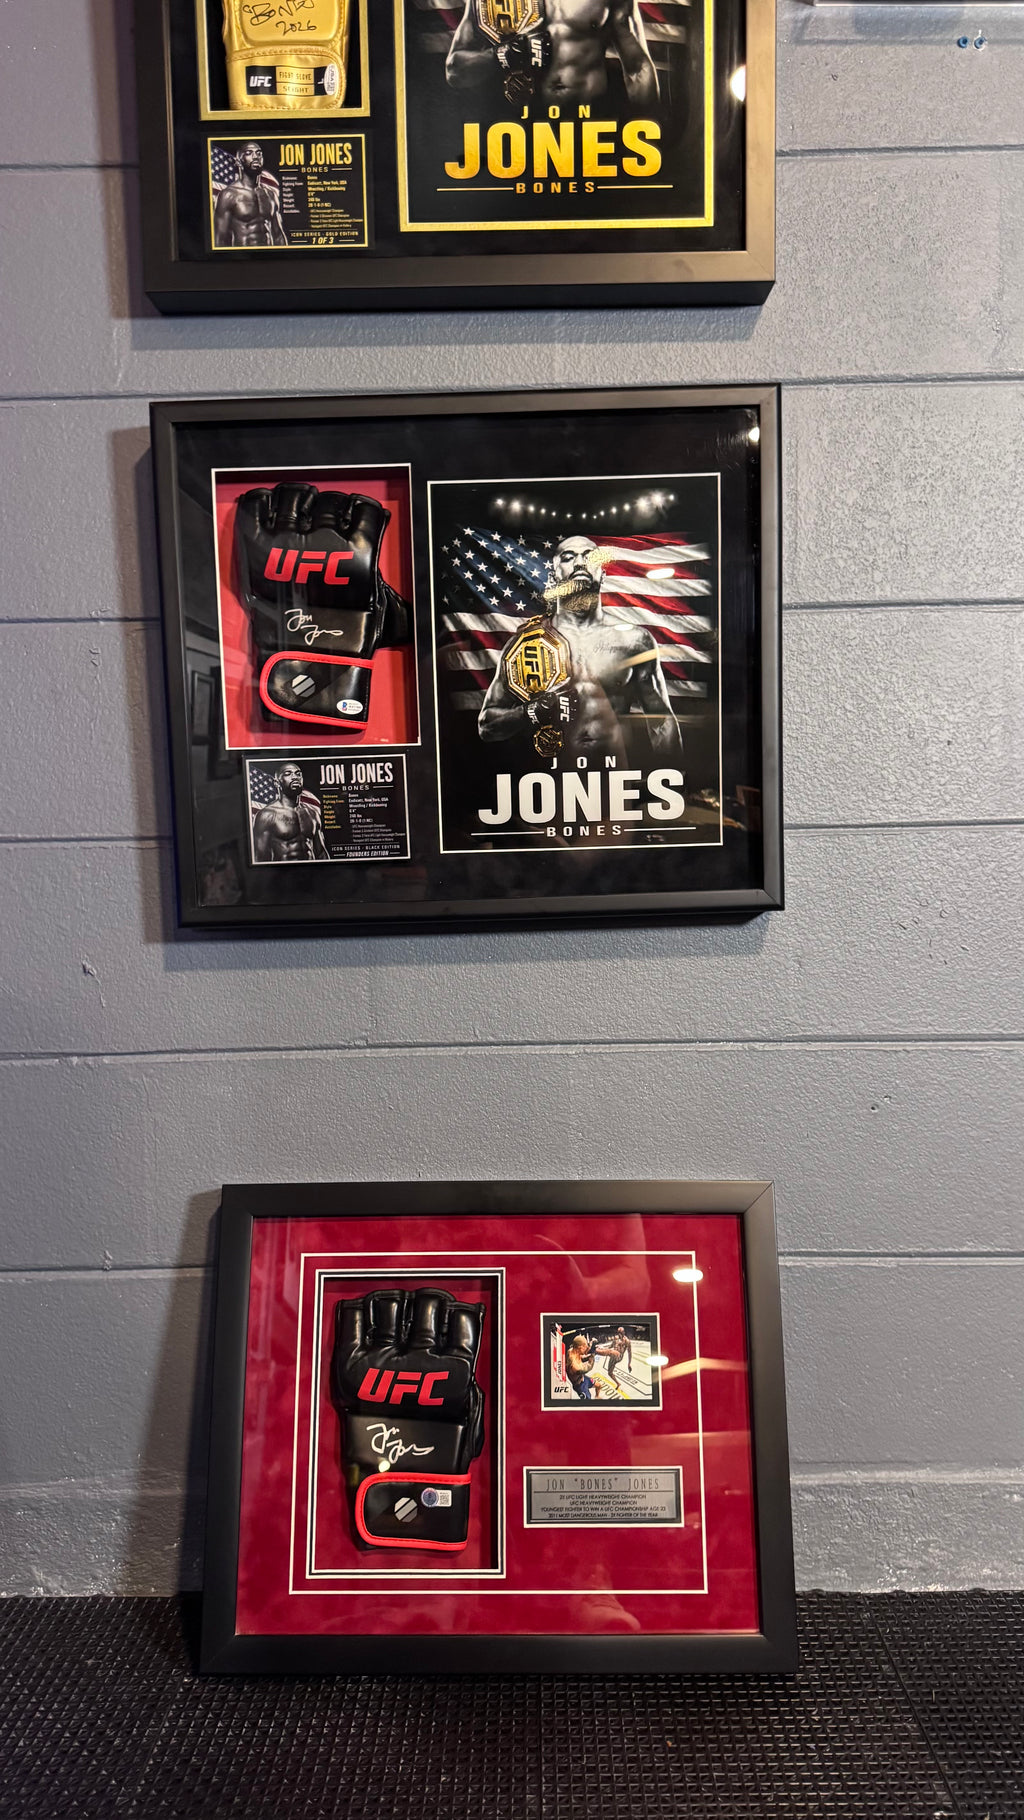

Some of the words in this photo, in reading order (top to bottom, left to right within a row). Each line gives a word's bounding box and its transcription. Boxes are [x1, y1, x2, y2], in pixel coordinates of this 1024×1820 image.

[275, 20, 317, 36] 2026
[531, 39, 542, 67] UFC
[249, 76, 272, 87] UFC
[521, 105, 590, 119] JON
[279, 144, 304, 166] JON
[310, 142, 352, 165] JONES
[444, 120, 662, 179] JONES
[516, 182, 595, 194] BONES
[317, 237, 328, 245] OF
[263, 547, 354, 586] UFC
[524, 646, 541, 687] UFC
[560, 696, 570, 722] UFC
[320, 764, 345, 785] JON
[351, 762, 394, 784] JONES
[550, 755, 617, 770] JON
[478, 768, 685, 825] JONES
[546, 824, 622, 837] BONES
[357, 1367, 450, 1406] UFC
[546, 1478, 565, 1491] JON
[574, 1477, 619, 1490] "BONES"
[628, 1478, 660, 1490] JONES
